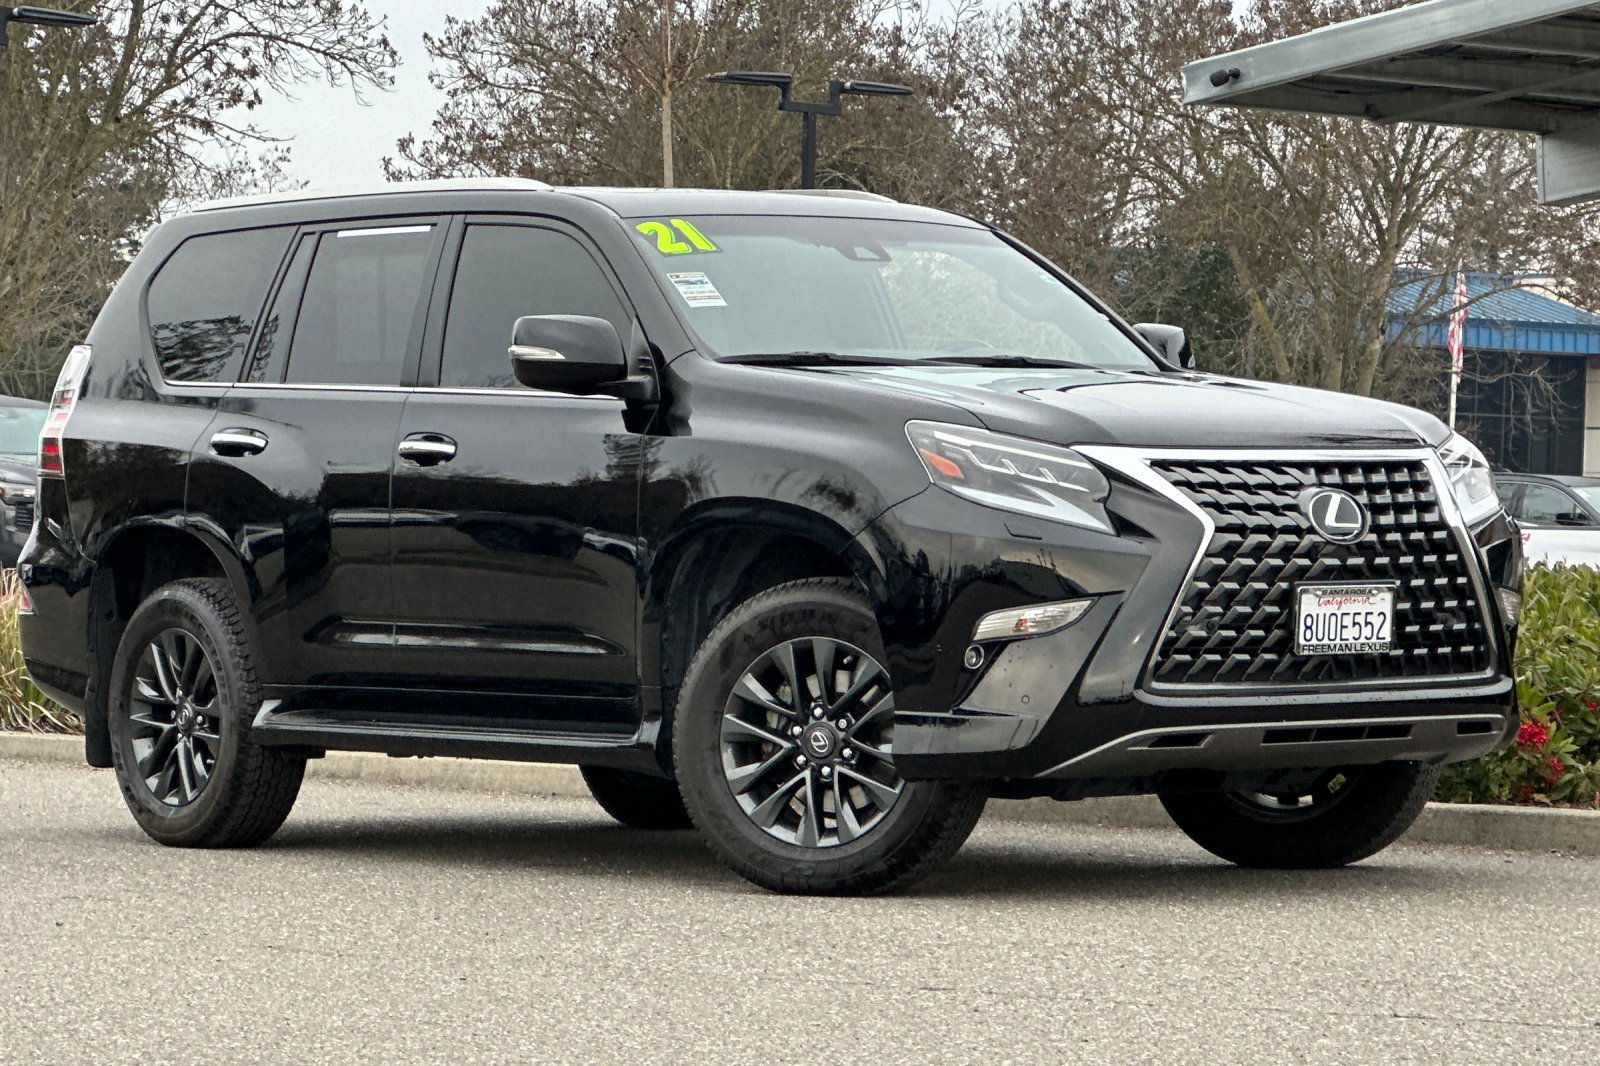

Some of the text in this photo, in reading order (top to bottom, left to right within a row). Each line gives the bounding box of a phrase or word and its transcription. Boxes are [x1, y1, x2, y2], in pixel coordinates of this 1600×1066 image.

[636, 219, 717, 254] 21
[1321, 587, 1373, 596] SANTA ROSA
[1317, 596, 1376, 610] California
[1302, 642, 1388, 653] FREEMAN LEXUS
